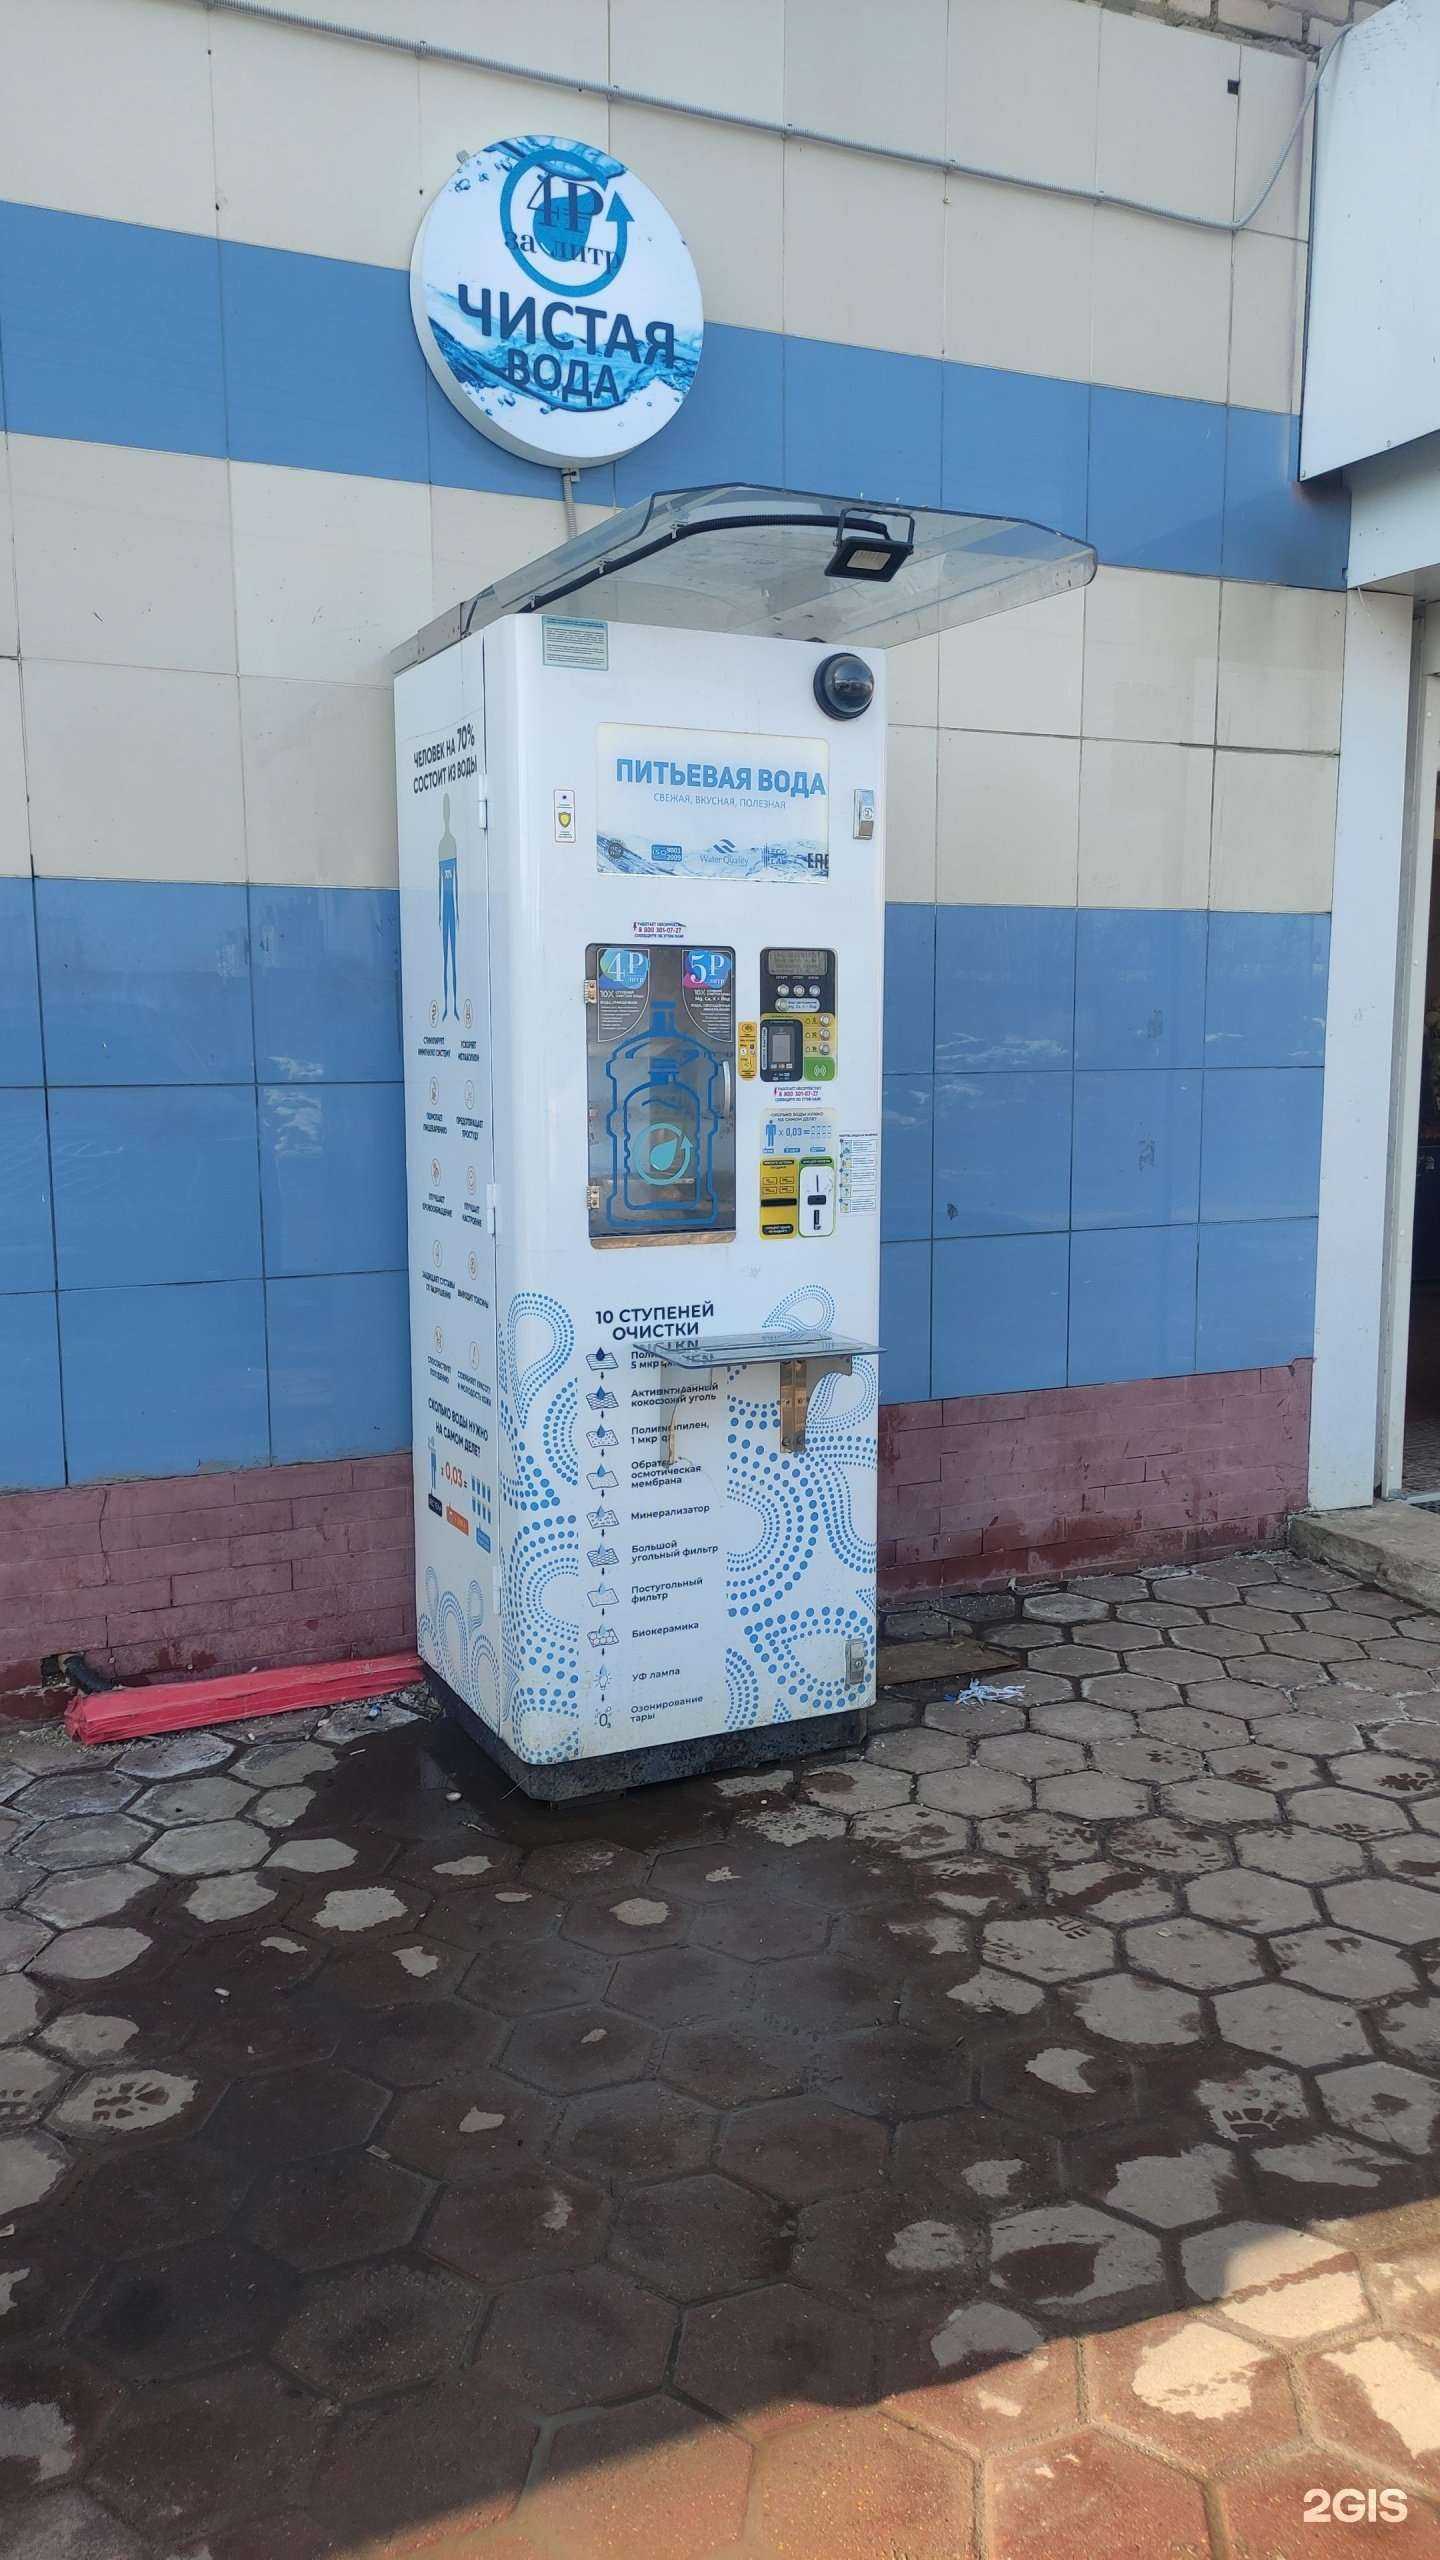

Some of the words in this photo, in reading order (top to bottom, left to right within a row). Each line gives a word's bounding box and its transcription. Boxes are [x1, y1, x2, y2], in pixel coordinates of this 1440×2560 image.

[505, 231, 537, 254] за
[458, 284, 675, 369] ЧИСТАЯ
[507, 348, 619, 407] ВОДА
[414, 742, 445, 768] ЧЕЛОВЕК
[446, 738, 456, 757] НА
[457, 723, 475, 752] 70%
[413, 768, 447, 794] СОСТОИТ
[448, 763, 456, 782] ИЗ
[457, 754, 477, 778] ВОДЫ
[616, 758, 751, 791] ПИТЬЕВАЯ
[758, 768, 826, 798] ВОДА
[653, 792, 693, 804] СВЕЖАЯ,
[695, 796, 738, 808] ВКУСНАЯ,
[739, 798, 786, 810] ПОЛЕЗНАЯ
[700, 854, 722, 865] Water
[723, 855, 749, 866] Quality
[786, 1127, 802, 1137] 0,03
[595, 1310, 614, 1324] 10
[619, 1300, 714, 1323] СТУПЕНЕЙ
[612, 1322, 699, 1341] ОЧИСТКИ
[631, 1361, 637, 1369] 5
[689, 1393, 718, 1404] уголь
[428, 1397, 451, 1420] СКОЛЬКО
[452, 1411, 468, 1429] ВОДЫ
[468, 1420, 489, 1442] НУЖНО
[435, 1421, 443, 1435] НА
[443, 1427, 463, 1448] САМОМ
[464, 1438, 481, 1458] ДЕЛЕ?
[637, 1436, 658, 1445] мкр
[445, 1461, 463, 1488] 0,03
[631, 1465, 702, 1479] осмотическая
[631, 1477, 682, 1489] мембрана
[631, 1505, 710, 1520] Минерализатор
[631, 1548, 680, 1565] угольный
[682, 1545, 719, 1557] фильтр
[632, 1540, 678, 1553] Большой
[631, 1577, 703, 1594] Постугольный
[631, 1592, 668, 1605] фильтр
[632, 1622, 699, 1638] Биокерамика
[632, 1673, 647, 1682] УФ
[649, 1668, 681, 1680] лампа
[631, 1696, 704, 1714] Озонирование
[631, 1713, 655, 1723] тары
